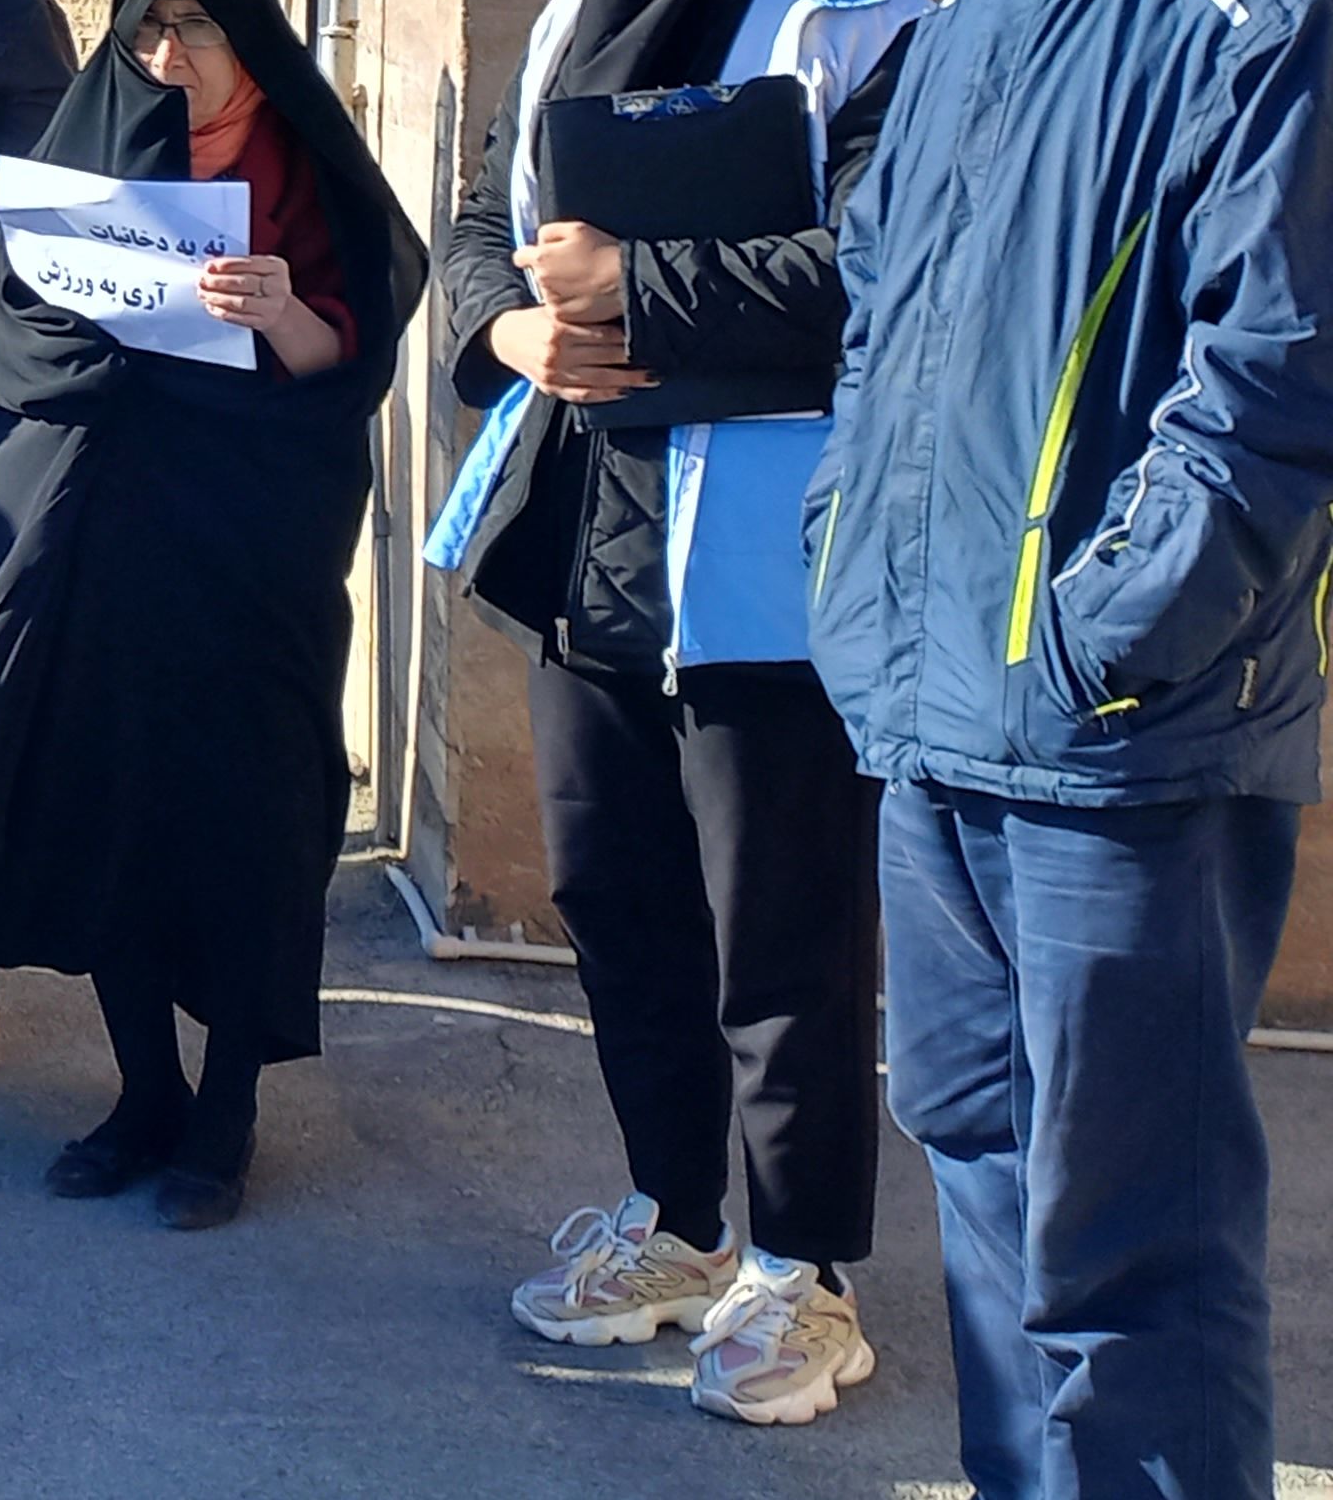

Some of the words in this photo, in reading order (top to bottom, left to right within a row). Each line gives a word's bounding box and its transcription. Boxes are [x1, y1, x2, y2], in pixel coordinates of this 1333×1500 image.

[88, 224, 170, 253] دخانیات
[175, 238, 197, 264] به
[203, 234, 226, 259] نه
[37, 260, 94, 298] ورزش
[99, 278, 118, 303] به
[123, 280, 169, 312] آری
